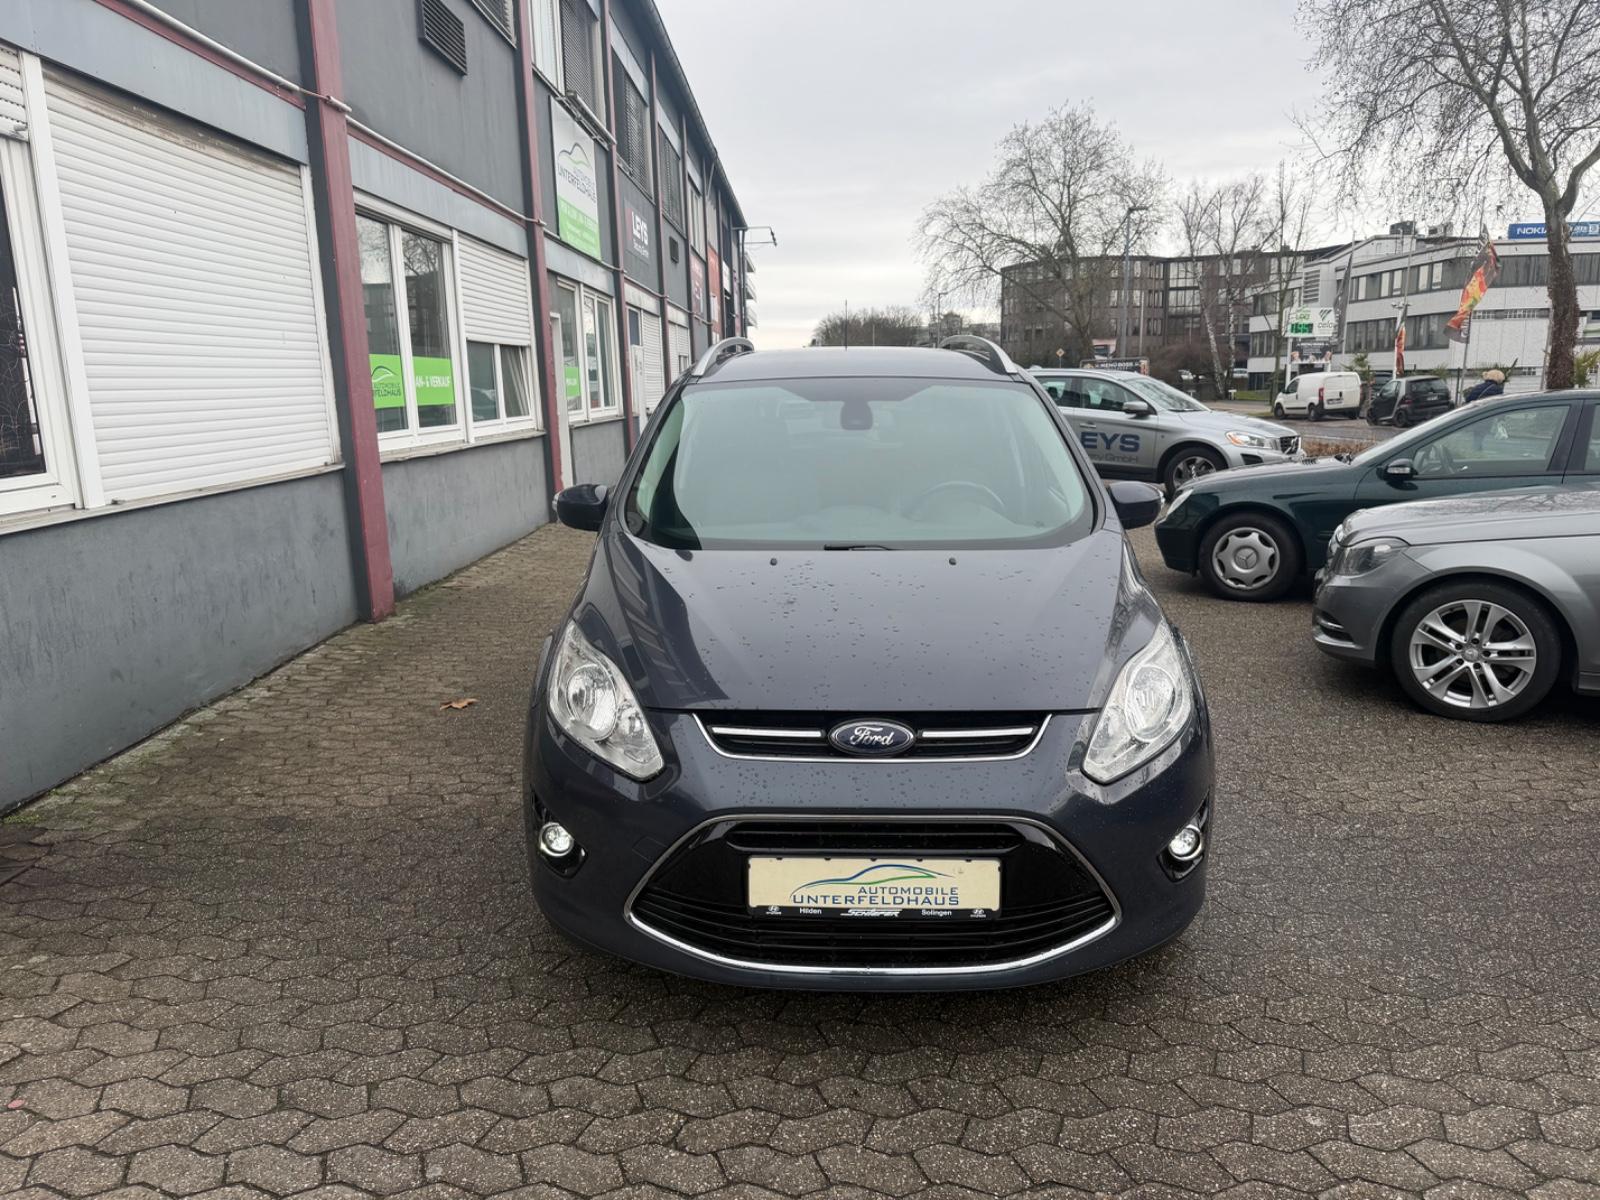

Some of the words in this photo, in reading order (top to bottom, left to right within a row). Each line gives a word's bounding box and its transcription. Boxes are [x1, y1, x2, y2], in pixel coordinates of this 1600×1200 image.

[631, 211, 649, 246] LEYS
[430, 375, 451, 388] VERKAUF
[373, 388, 402, 397] FELDHAUS
[1080, 432, 1140, 453] EYS
[849, 726, 895, 745] Ford
[857, 886, 959, 896] AUTOMOBILE
[792, 894, 960, 906] UNTERFELDHAUS
[799, 907, 822, 915] Hilden
[921, 909, 953, 917] Solingen
